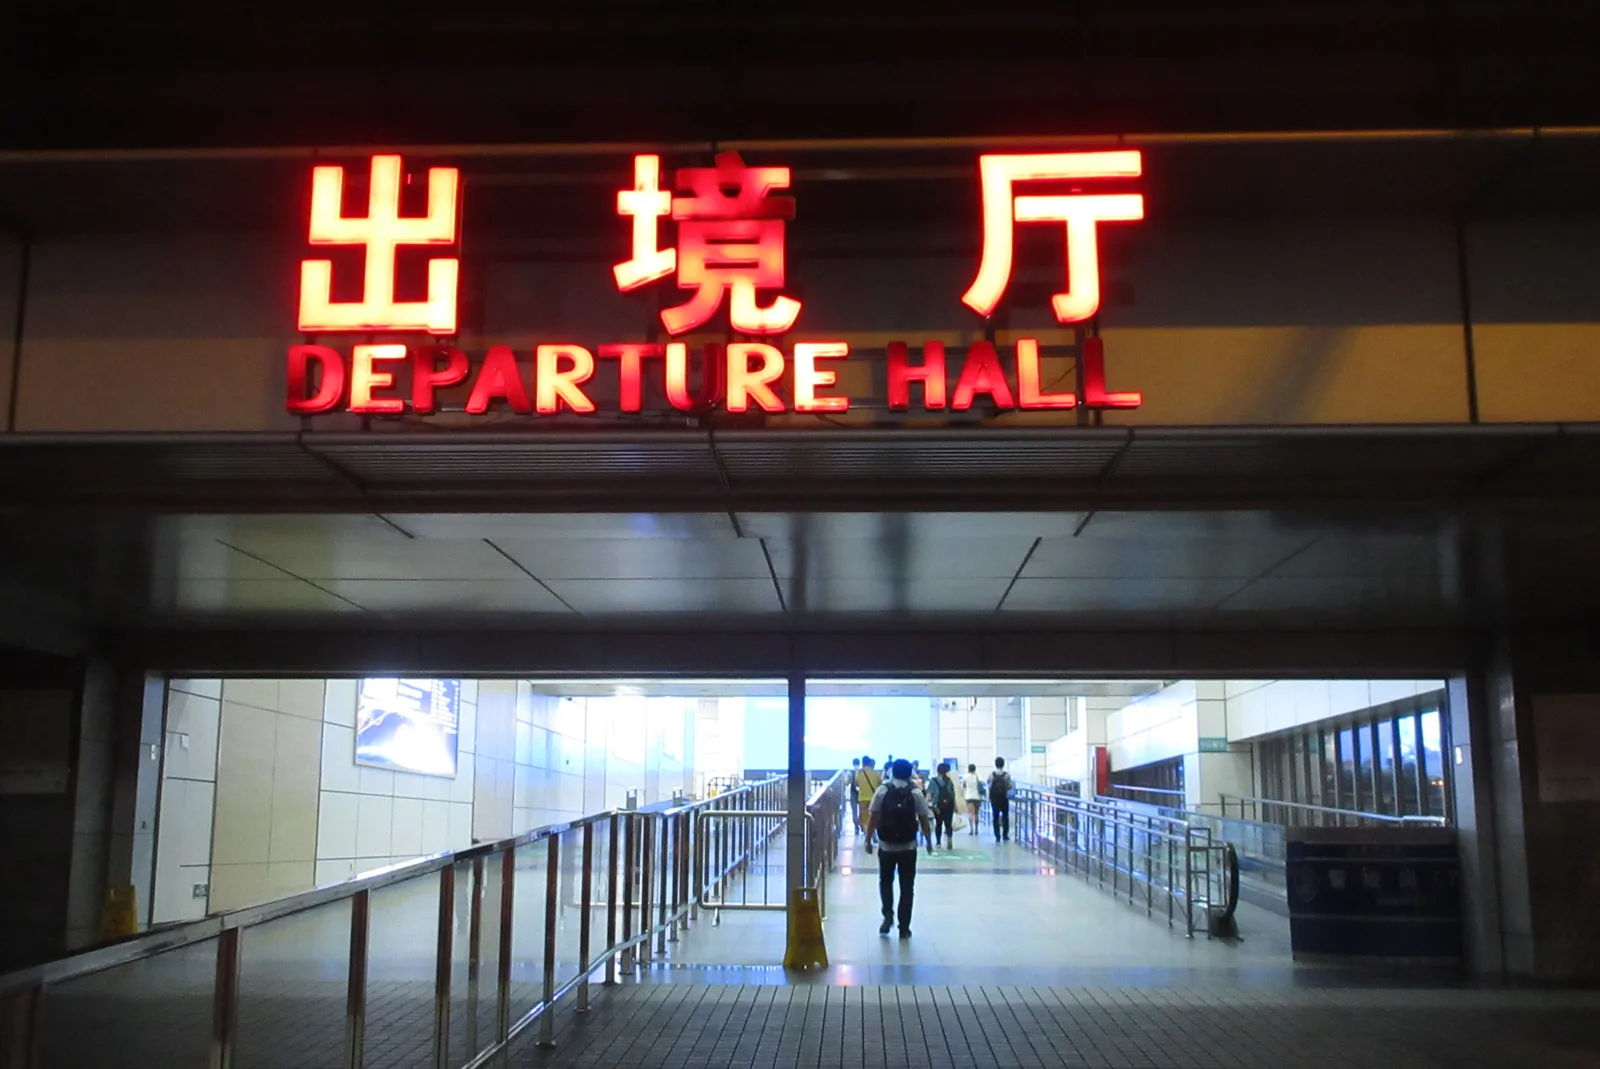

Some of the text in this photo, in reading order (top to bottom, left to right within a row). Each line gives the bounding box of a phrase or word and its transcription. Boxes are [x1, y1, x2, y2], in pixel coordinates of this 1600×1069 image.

[297, 149, 1146, 336] 出境厅
[286, 337, 1142, 415] DEPARTURE HALL
